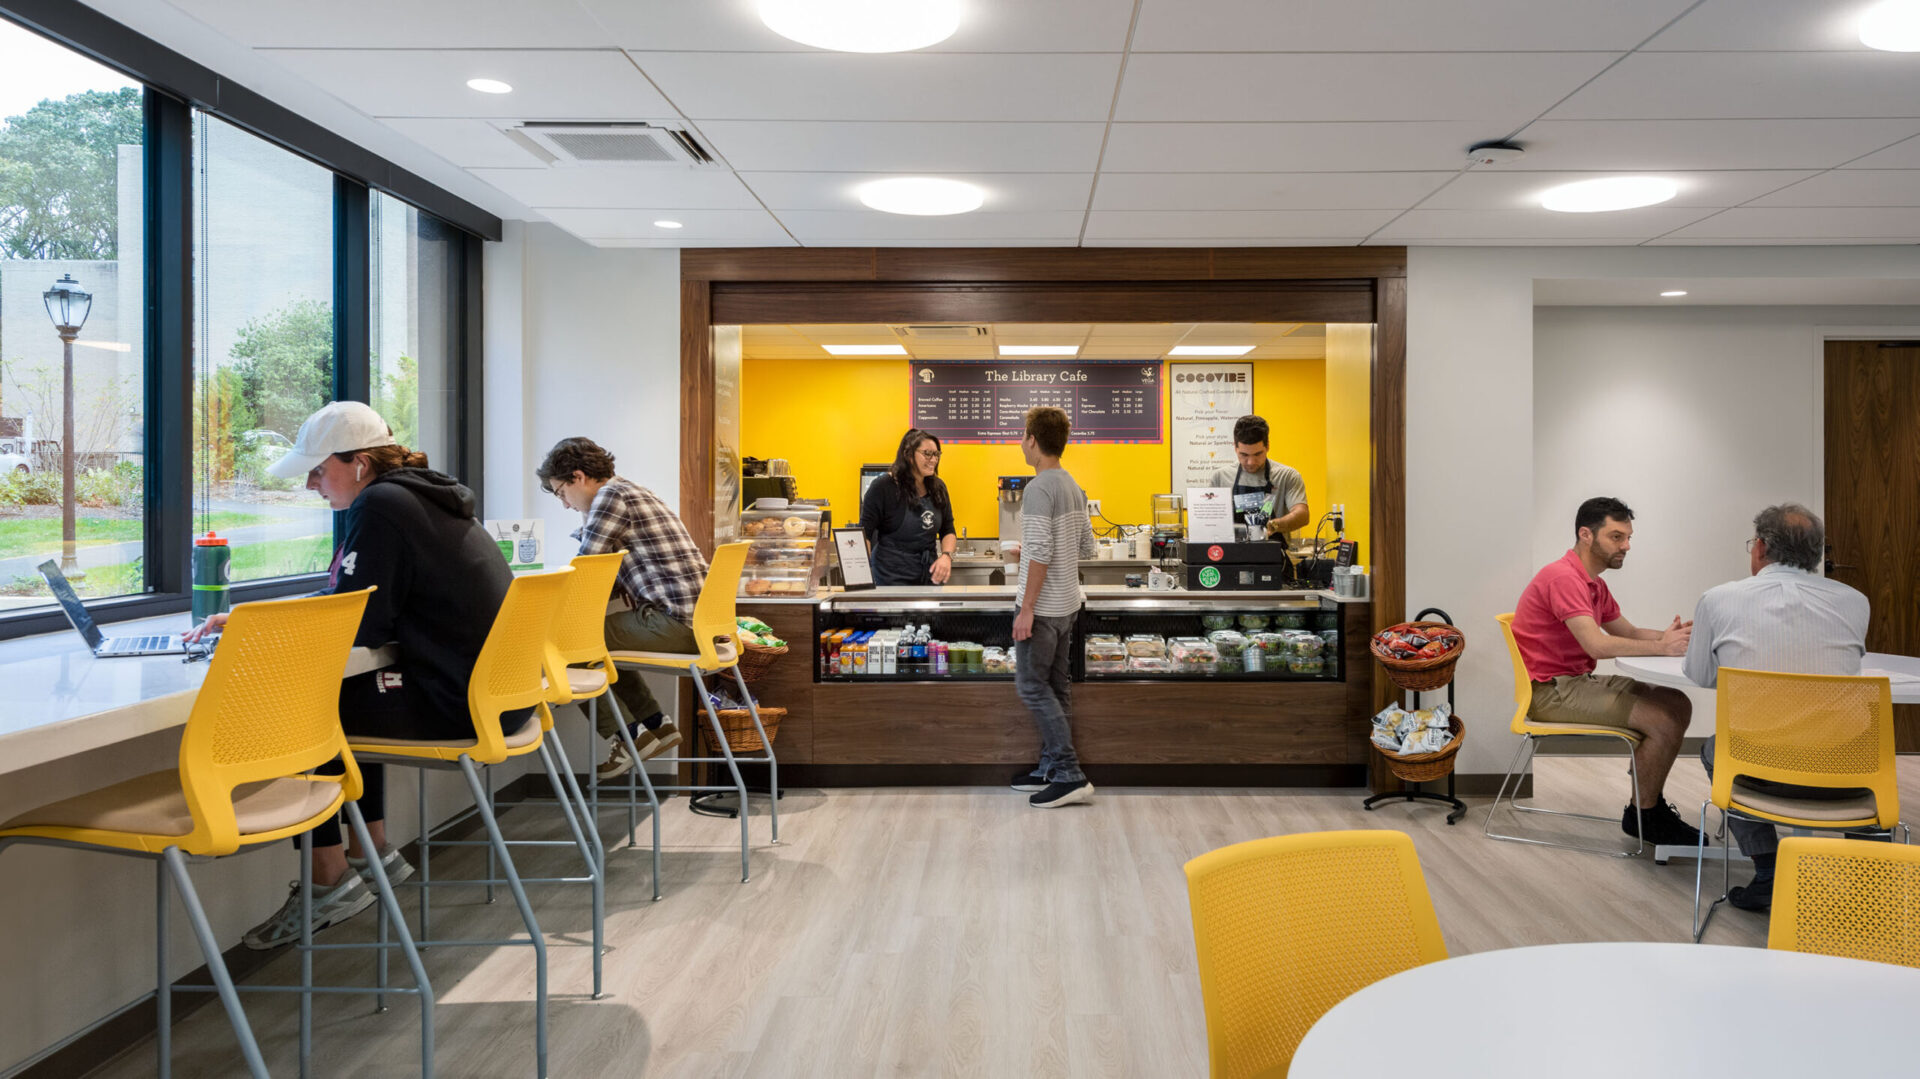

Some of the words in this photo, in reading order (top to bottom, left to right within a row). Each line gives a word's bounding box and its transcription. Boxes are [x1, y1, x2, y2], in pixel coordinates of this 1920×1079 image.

[985, 370, 1008, 382] The
[1012, 370, 1056, 384] Library
[1060, 370, 1087, 382] Cafe
[1176, 373, 1245, 383] COCOVIBE
[342, 551, 358, 576] 4
